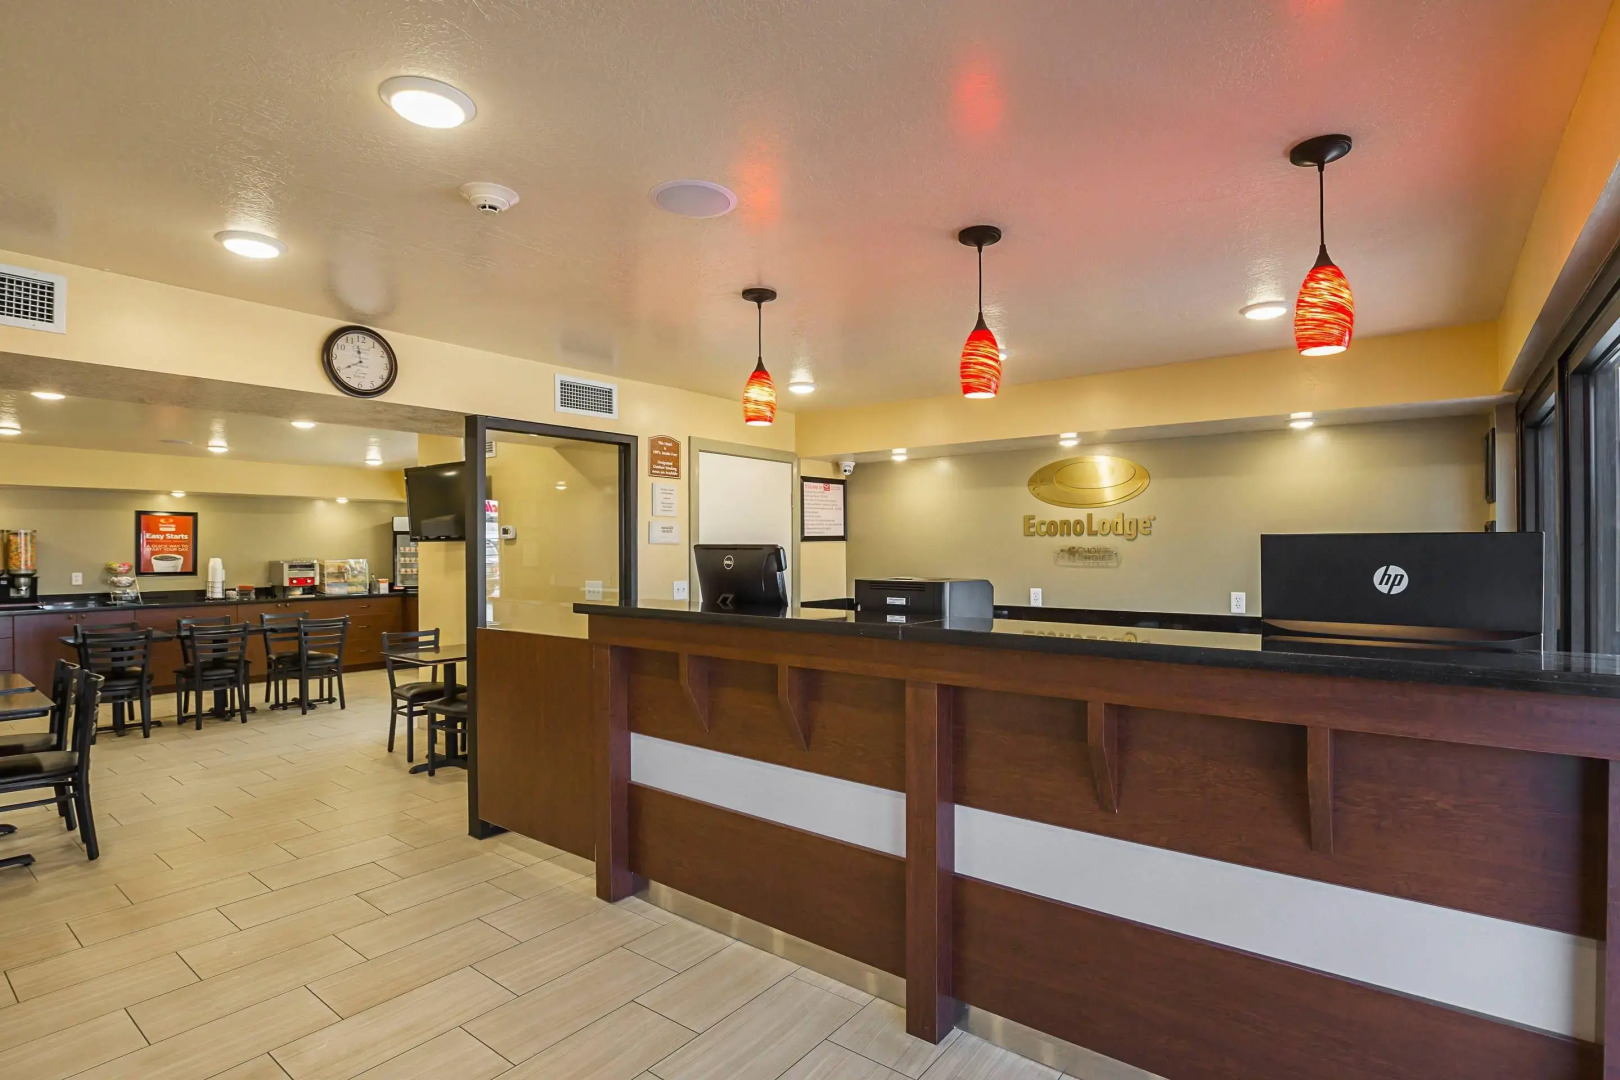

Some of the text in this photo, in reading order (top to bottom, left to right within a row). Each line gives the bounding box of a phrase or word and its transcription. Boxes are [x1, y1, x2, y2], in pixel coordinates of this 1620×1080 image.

[345, 336, 354, 344] 11
[357, 335, 366, 343] 12
[380, 350, 385, 358] 2
[145, 532, 164, 541] Easy
[1377, 565, 1406, 594] hp
